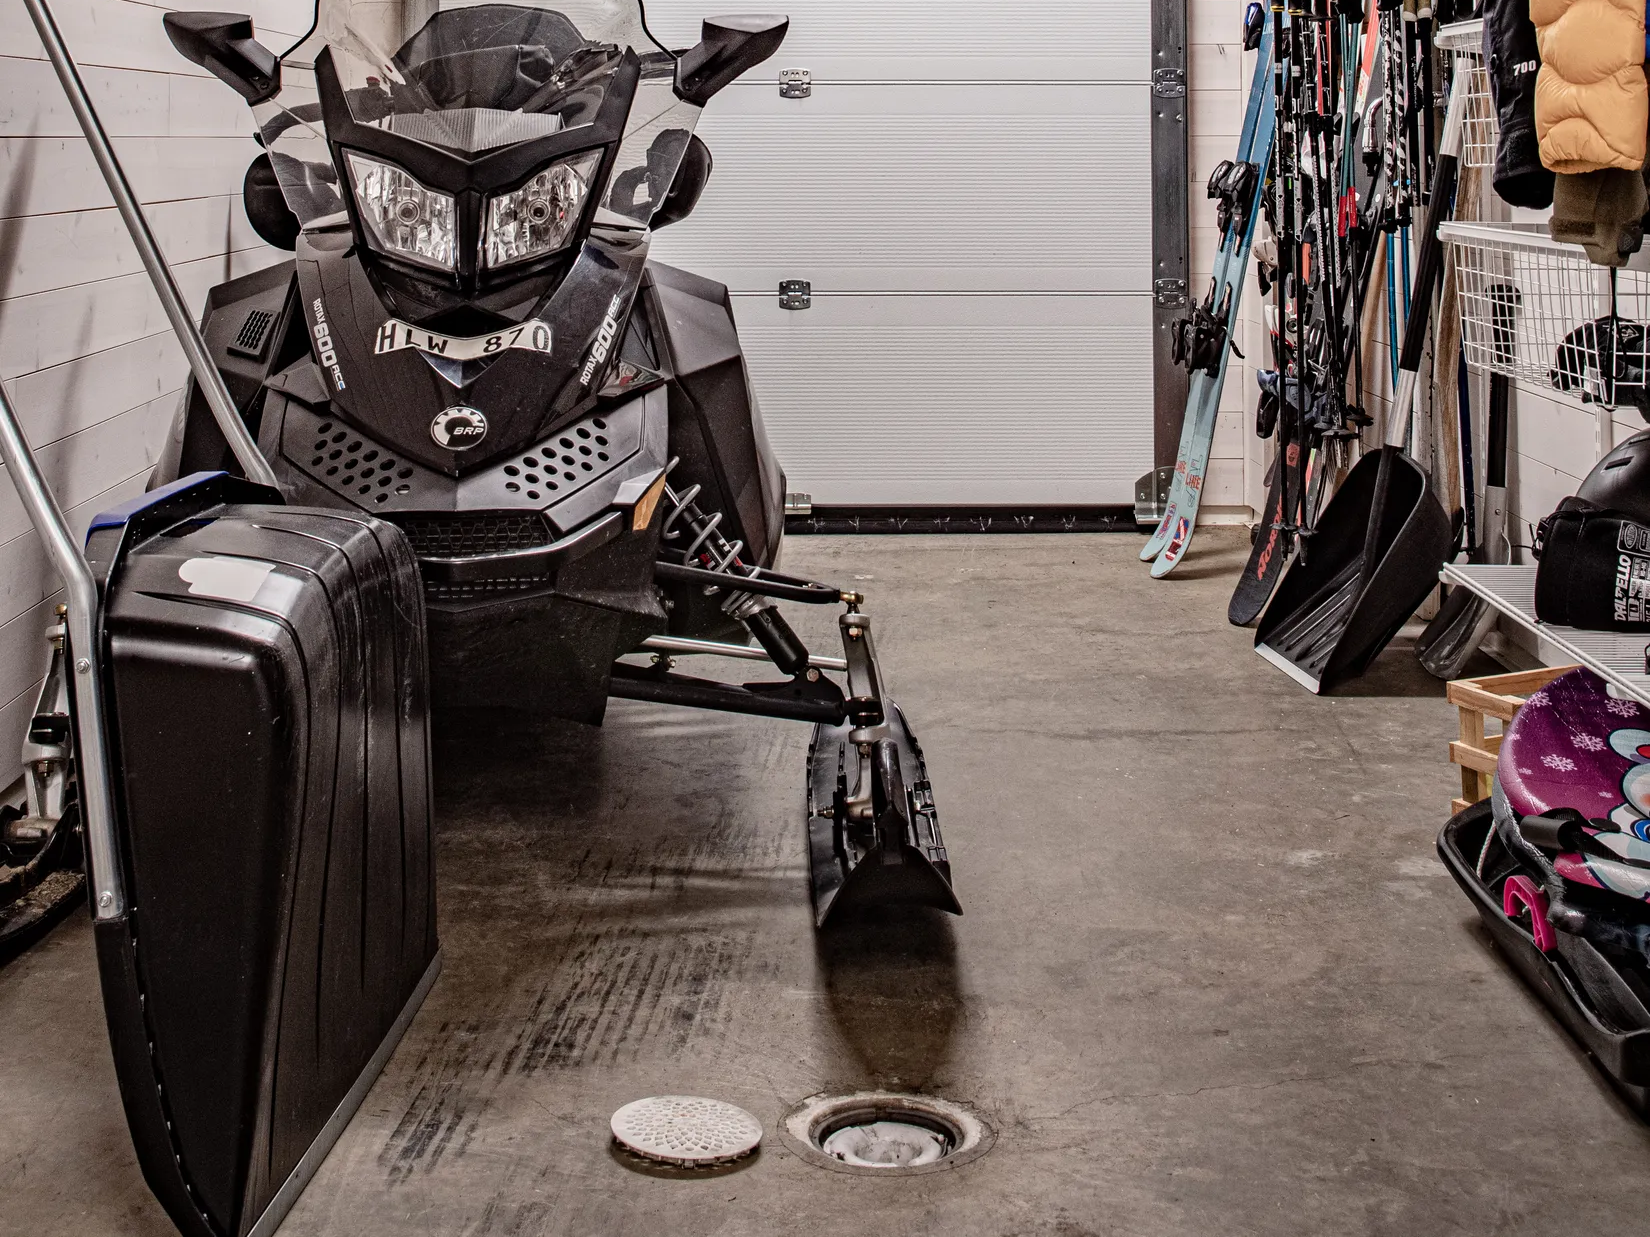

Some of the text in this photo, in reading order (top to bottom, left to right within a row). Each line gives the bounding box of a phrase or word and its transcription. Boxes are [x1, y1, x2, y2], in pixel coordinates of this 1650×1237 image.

[1512, 59, 1537, 77] 700
[313, 297, 326, 324] ROTAX
[313, 322, 338, 368] 600
[378, 323, 550, 354] HLW 870
[580, 355, 598, 386] ROTAX
[592, 314, 617, 363] 600
[453, 426, 485, 436] BRP
